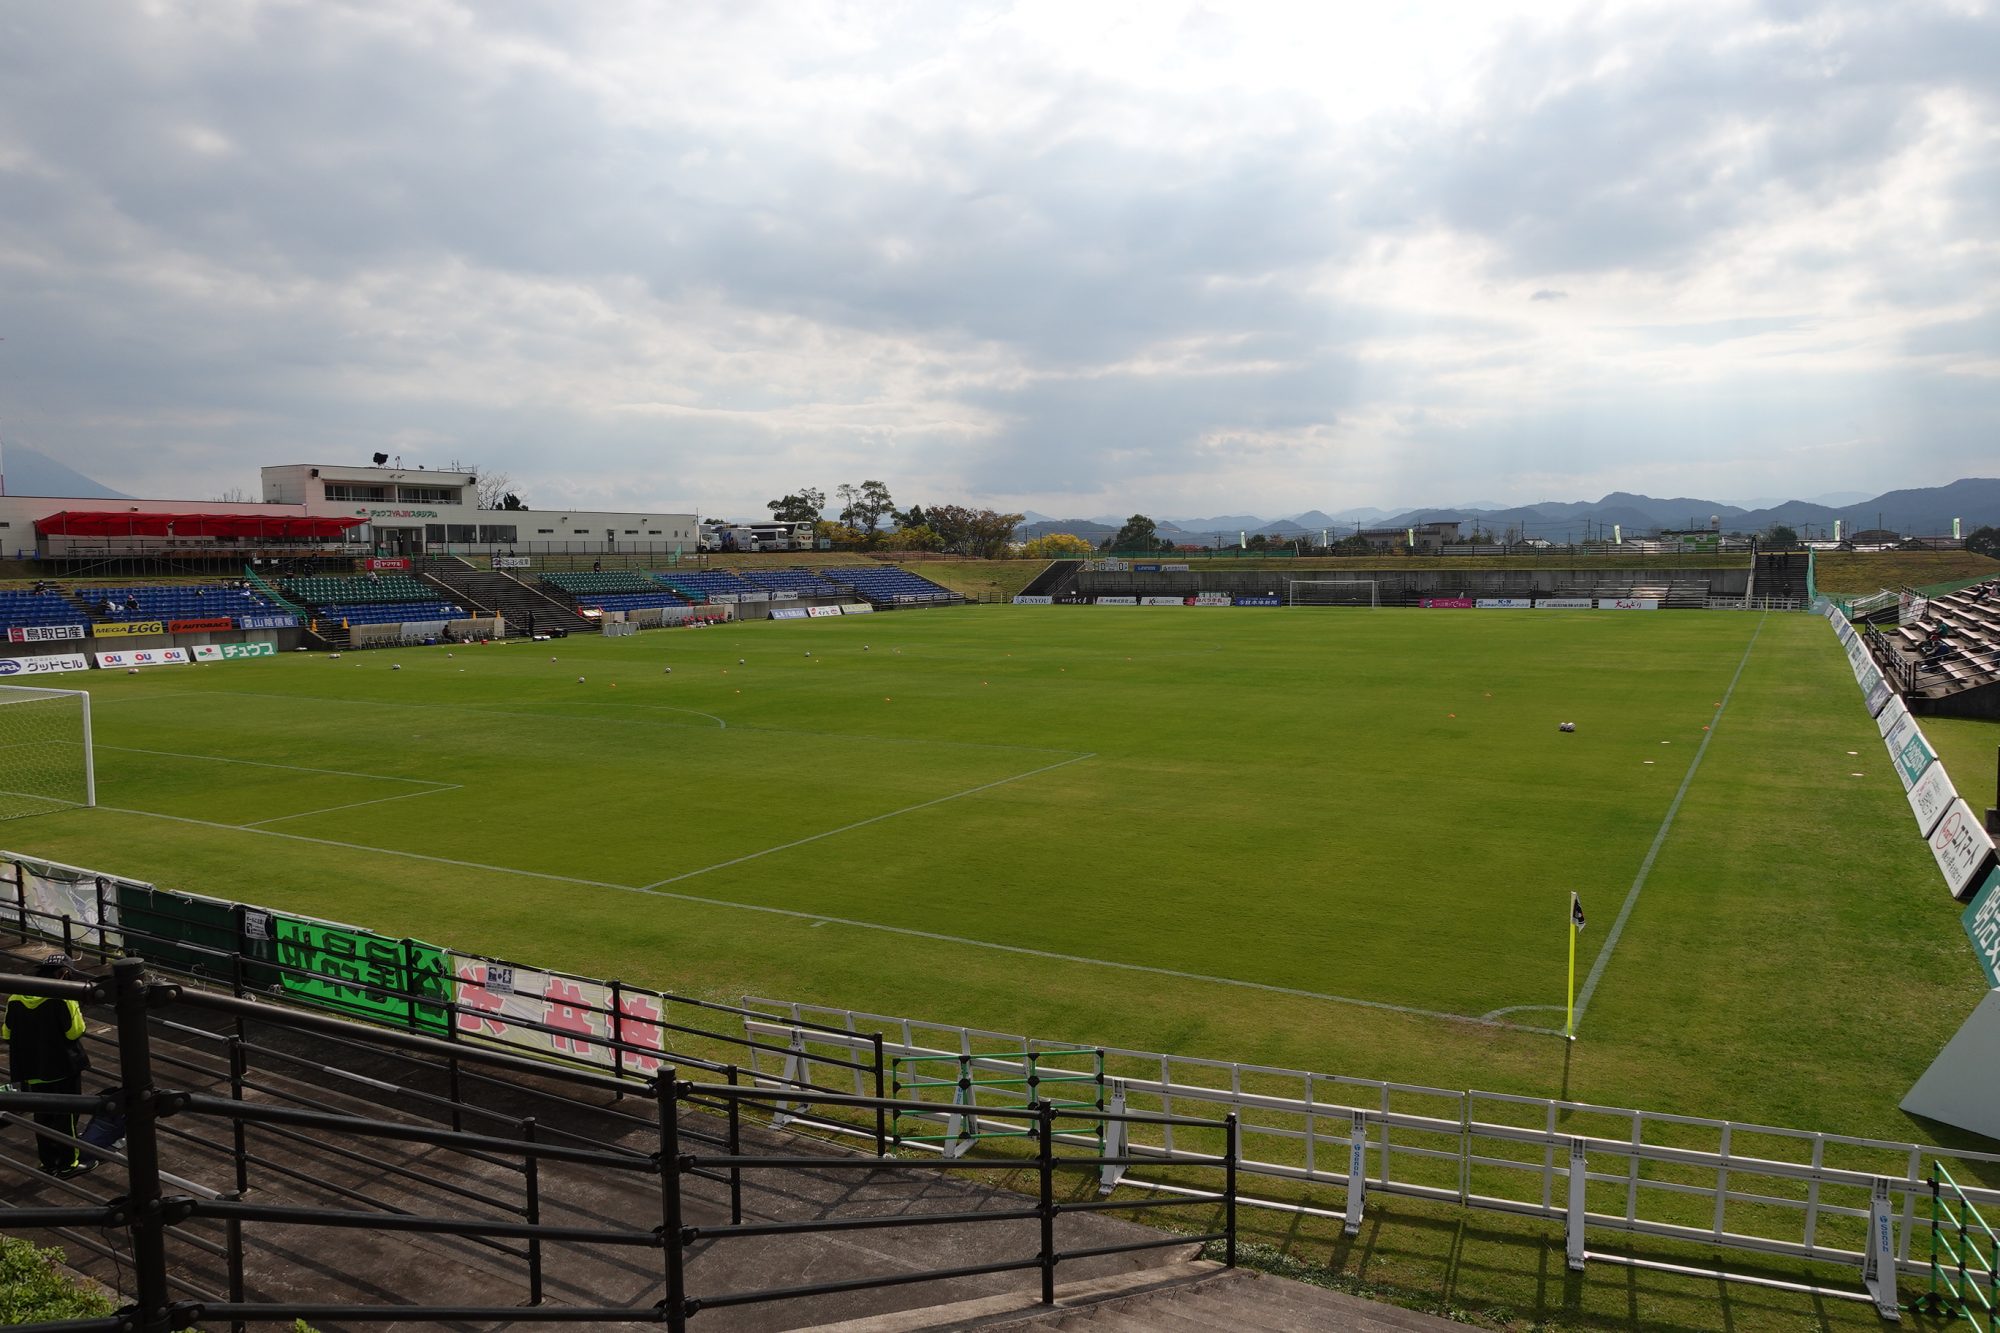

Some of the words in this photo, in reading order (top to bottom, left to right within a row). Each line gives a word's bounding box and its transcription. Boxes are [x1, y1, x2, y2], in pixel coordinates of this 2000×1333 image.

[127, 622, 161, 634] EGG
[182, 621, 230, 629] AUTOBACS
[26, 626, 82, 640] 鳥取日産
[104, 655, 122, 663] OU
[135, 653, 152, 661] OU
[164, 651, 181, 659] OU
[27, 659, 83, 672] グッドヒル
[1880, 1223, 1889, 1253] Senoh
